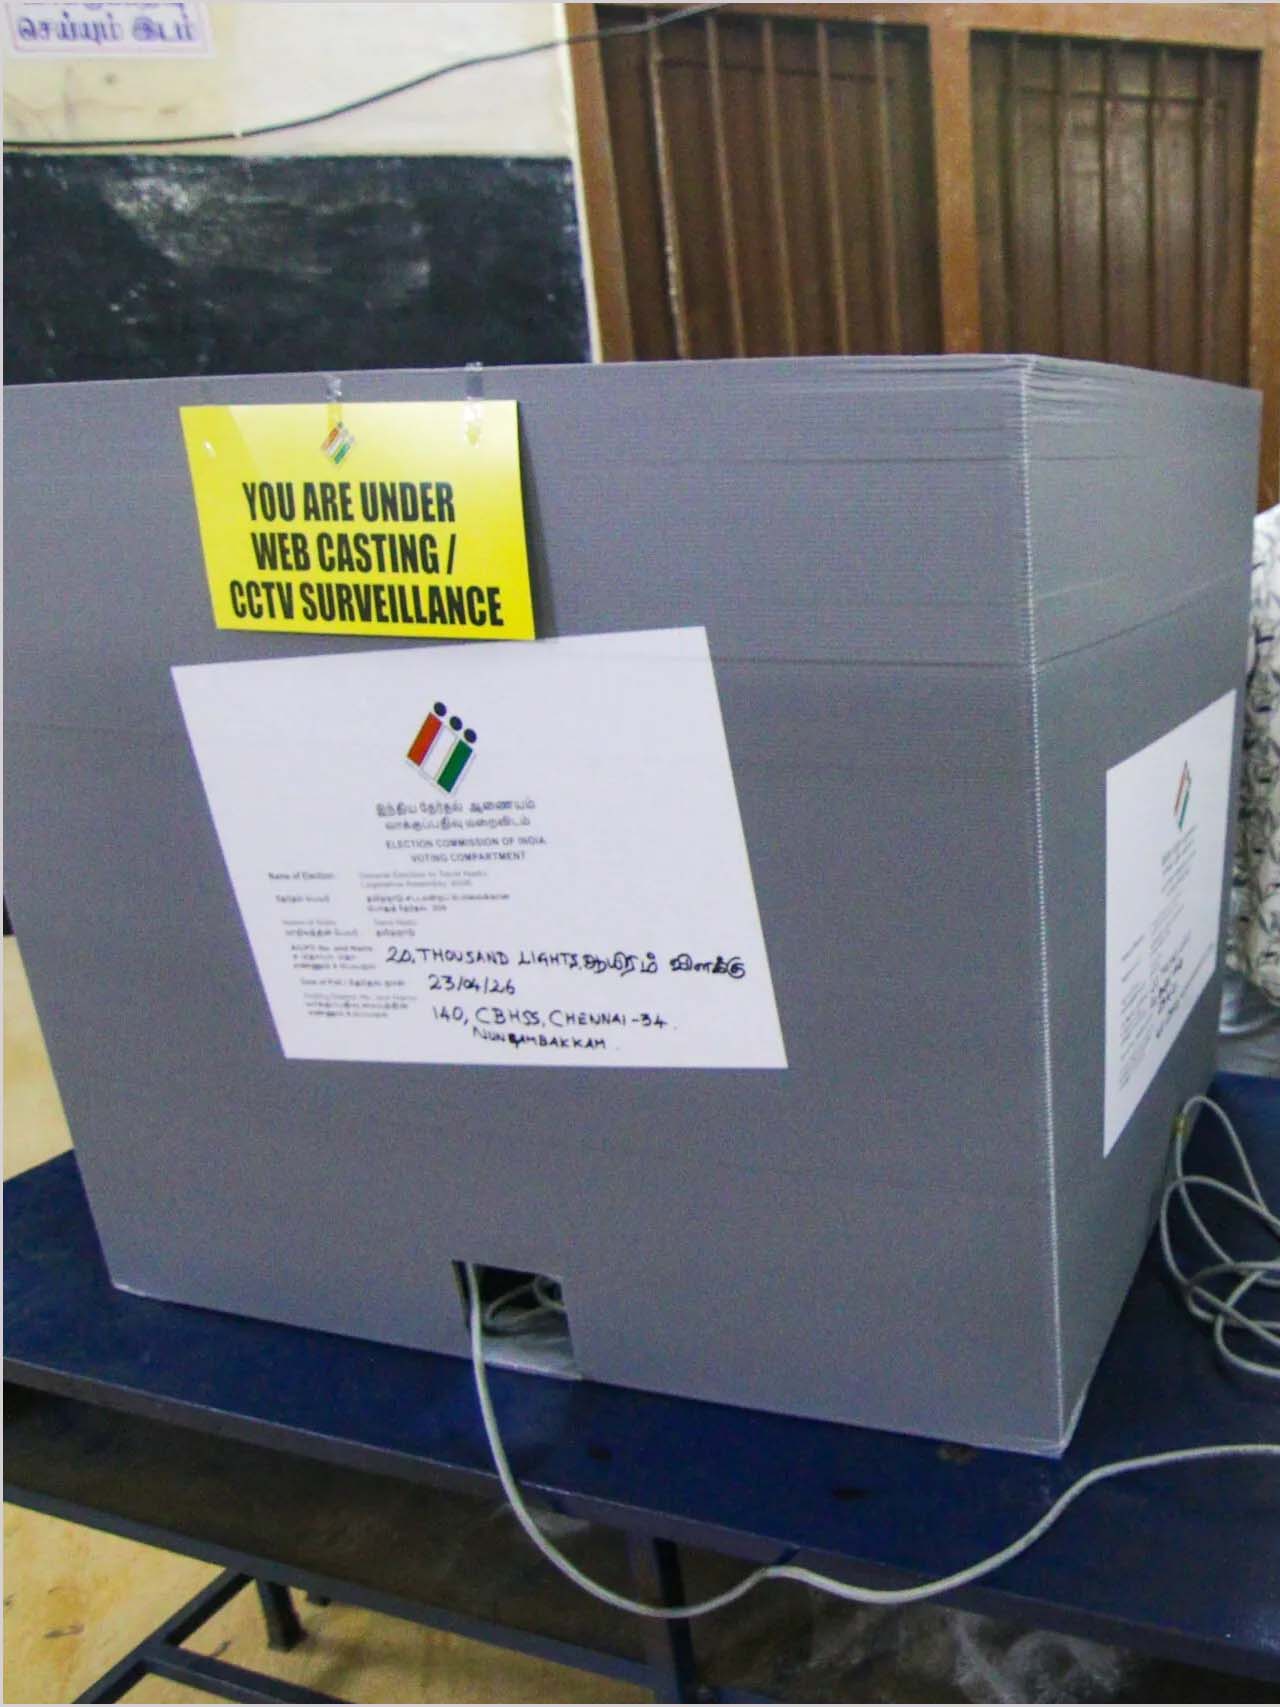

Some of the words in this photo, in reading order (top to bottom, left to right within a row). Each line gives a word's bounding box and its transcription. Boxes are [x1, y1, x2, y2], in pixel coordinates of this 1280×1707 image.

[242, 481, 296, 522] YOU
[303, 482, 355, 522] ARE
[359, 481, 456, 523] UNDER
[250, 532, 309, 571] WEB
[316, 533, 440, 574] CASTING
[229, 580, 296, 619] CCTV
[300, 582, 504, 626] SURVEILLANCE
[385, 839, 433, 849] ELECTION
[435, 837, 499, 848] COMMISSION
[502, 837, 514, 846] OF
[518, 836, 546, 845] INDIA
[410, 853, 448, 863] VOTING
[450, 851, 525, 862] COMPARTMENT
[416, 947, 510, 966] THOUSAND
[428, 973, 517, 996] 23/04/26
